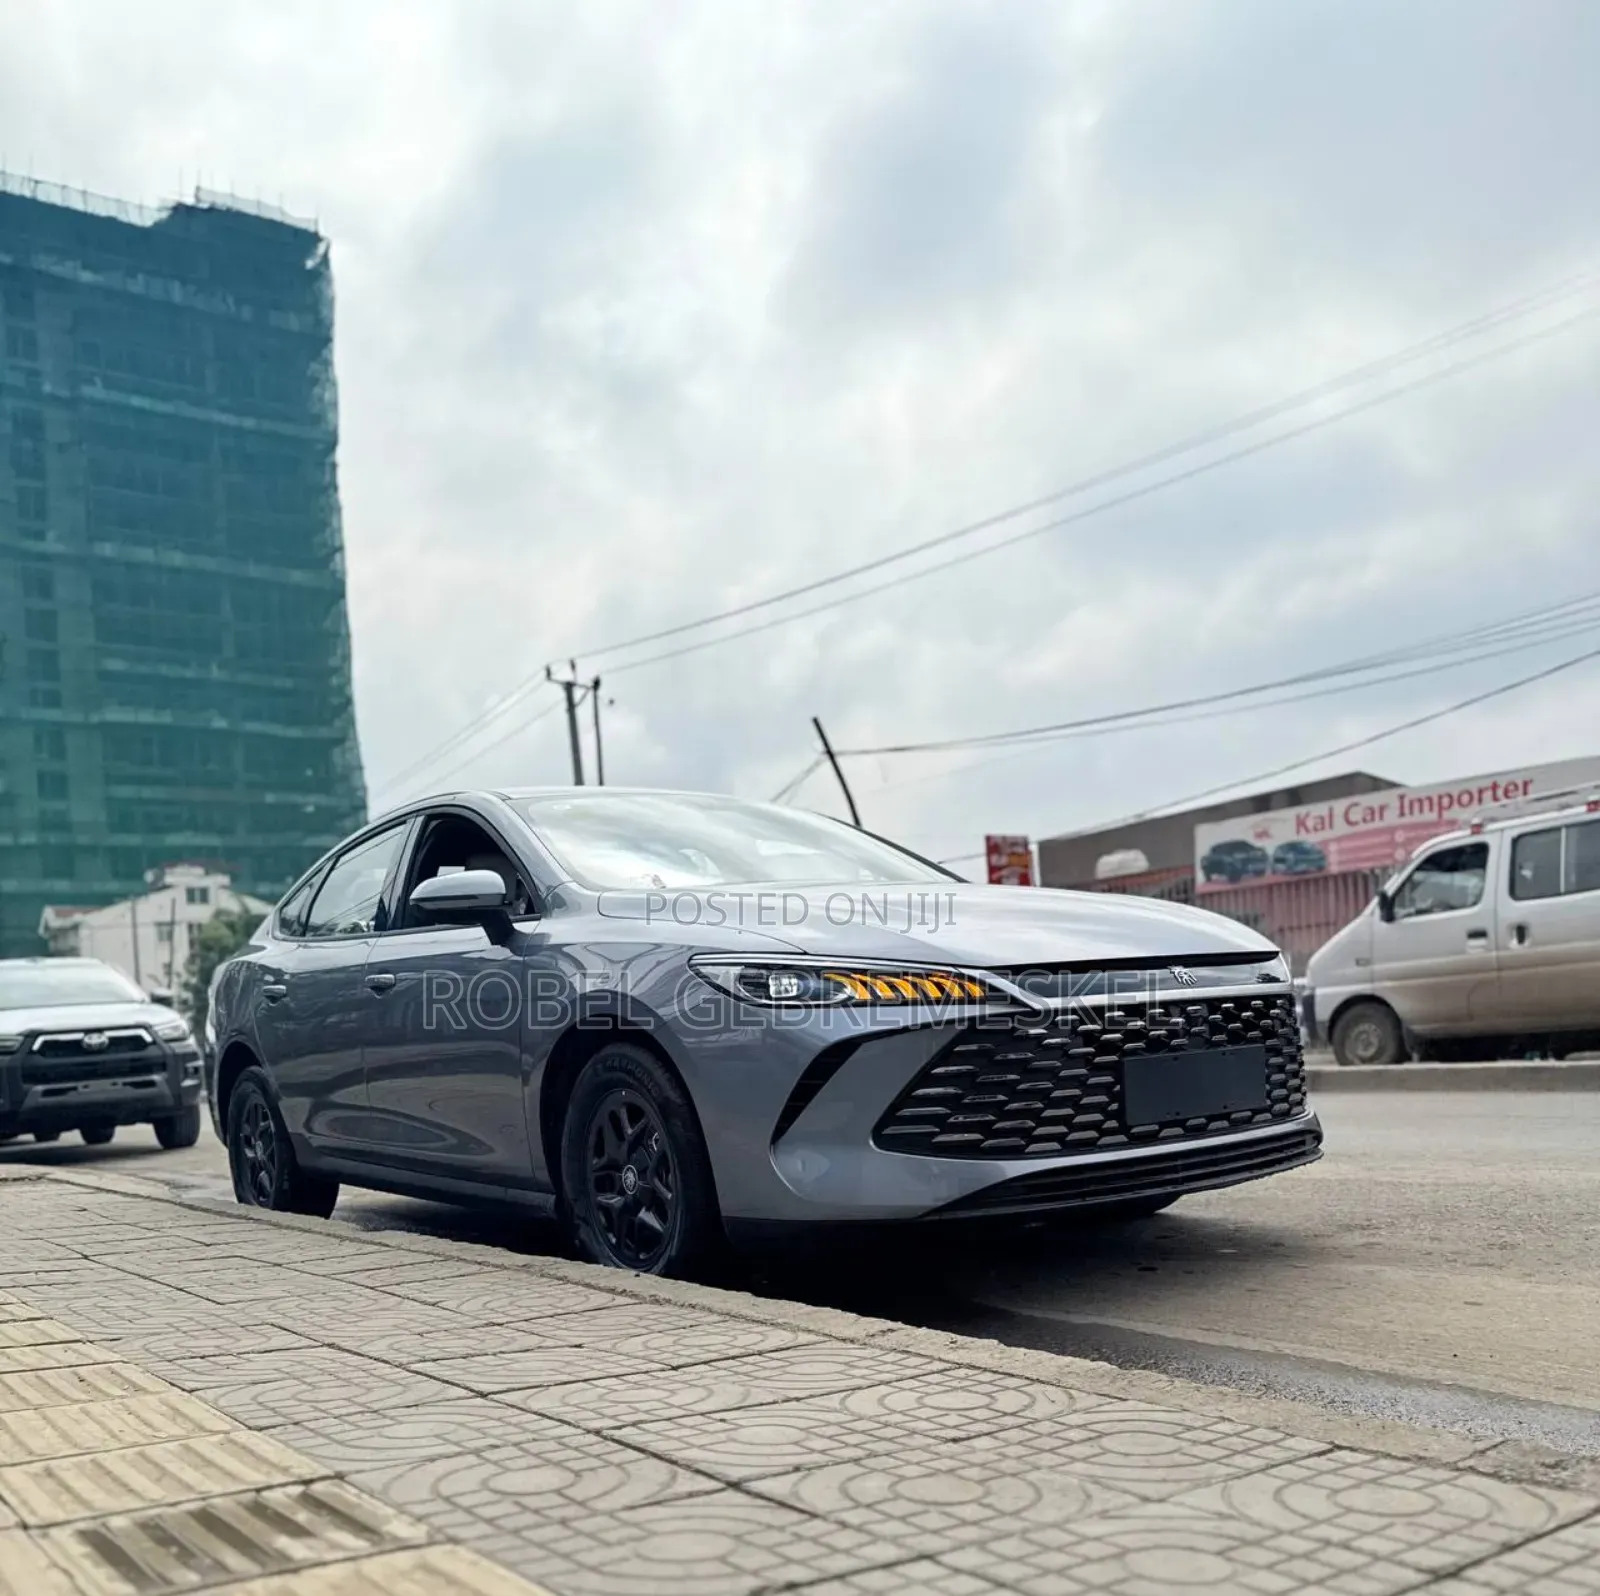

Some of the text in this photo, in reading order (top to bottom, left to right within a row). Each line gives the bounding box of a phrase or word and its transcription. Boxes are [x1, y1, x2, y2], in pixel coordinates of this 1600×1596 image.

[1294, 807, 1334, 836] Kal
[1343, 802, 1389, 828] Car
[1397, 778, 1533, 820] Importer
